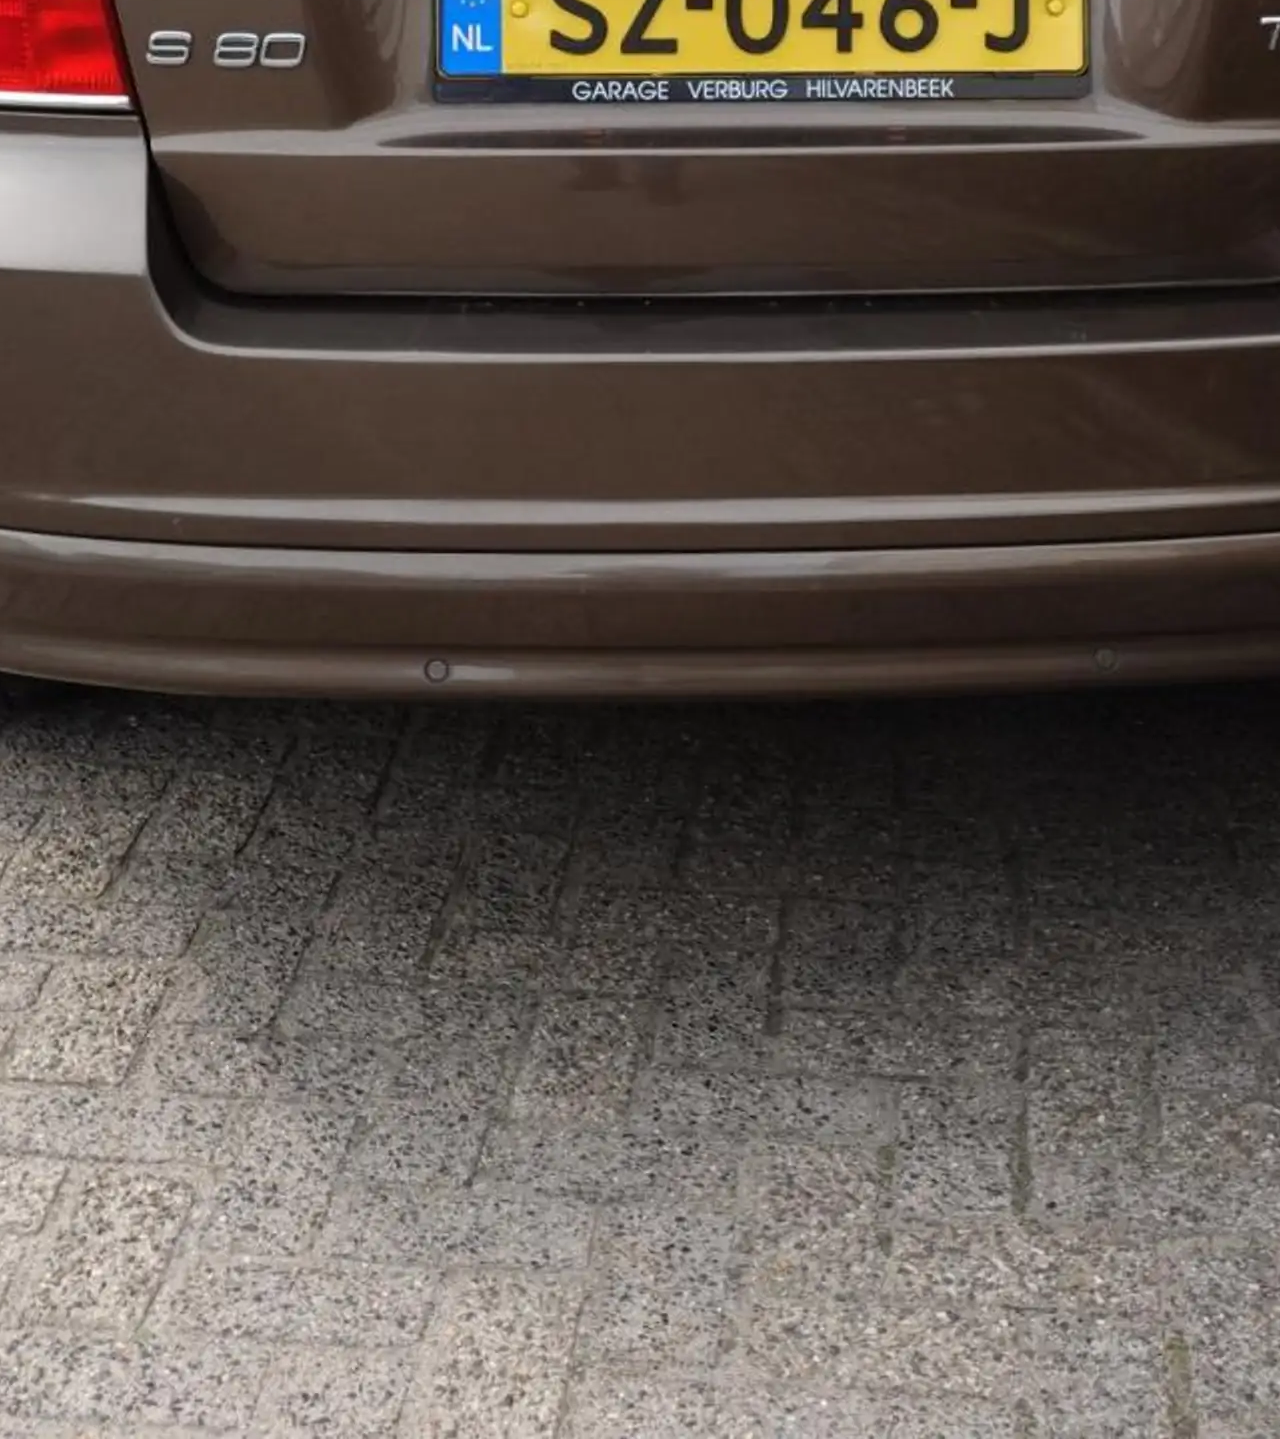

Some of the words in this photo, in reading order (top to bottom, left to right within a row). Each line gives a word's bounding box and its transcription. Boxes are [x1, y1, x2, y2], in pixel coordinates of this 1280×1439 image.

[451, 23, 495, 52] NL
[571, 80, 669, 102] GARAGE
[686, 78, 789, 100] VERBURG
[806, 77, 956, 99] HILVARENBEEK
